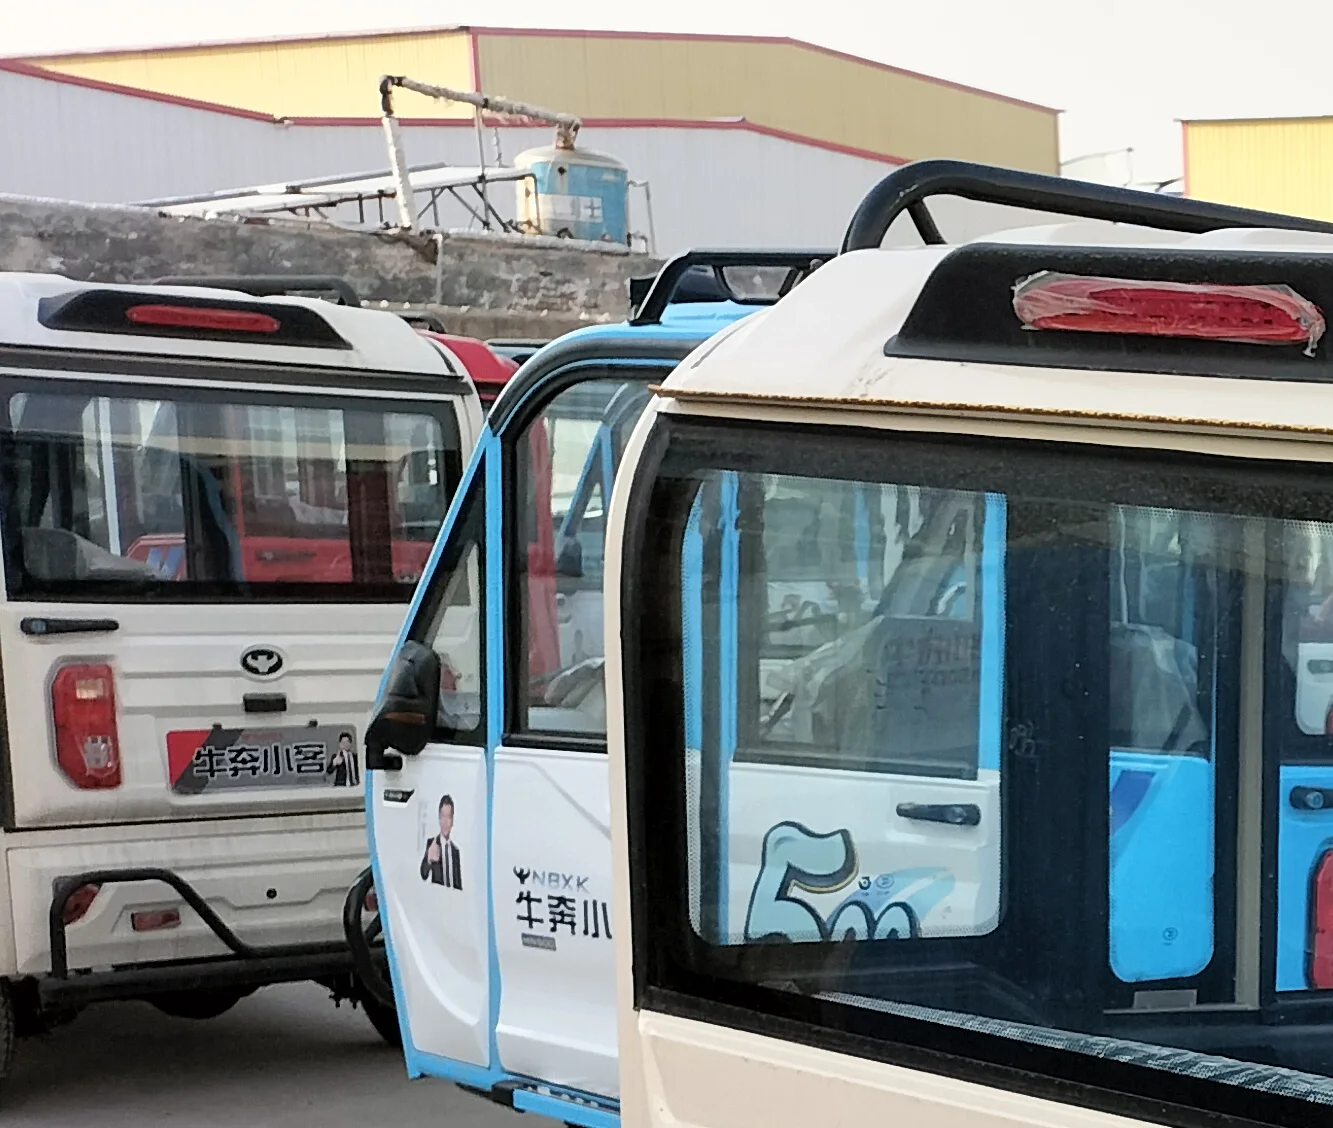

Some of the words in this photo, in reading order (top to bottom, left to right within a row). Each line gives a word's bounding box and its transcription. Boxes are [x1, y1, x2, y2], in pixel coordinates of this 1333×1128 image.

[193, 742, 327, 780] 牛奔小客
[532, 869, 589, 893] NBXK
[515, 890, 613, 939] 牛奔小
